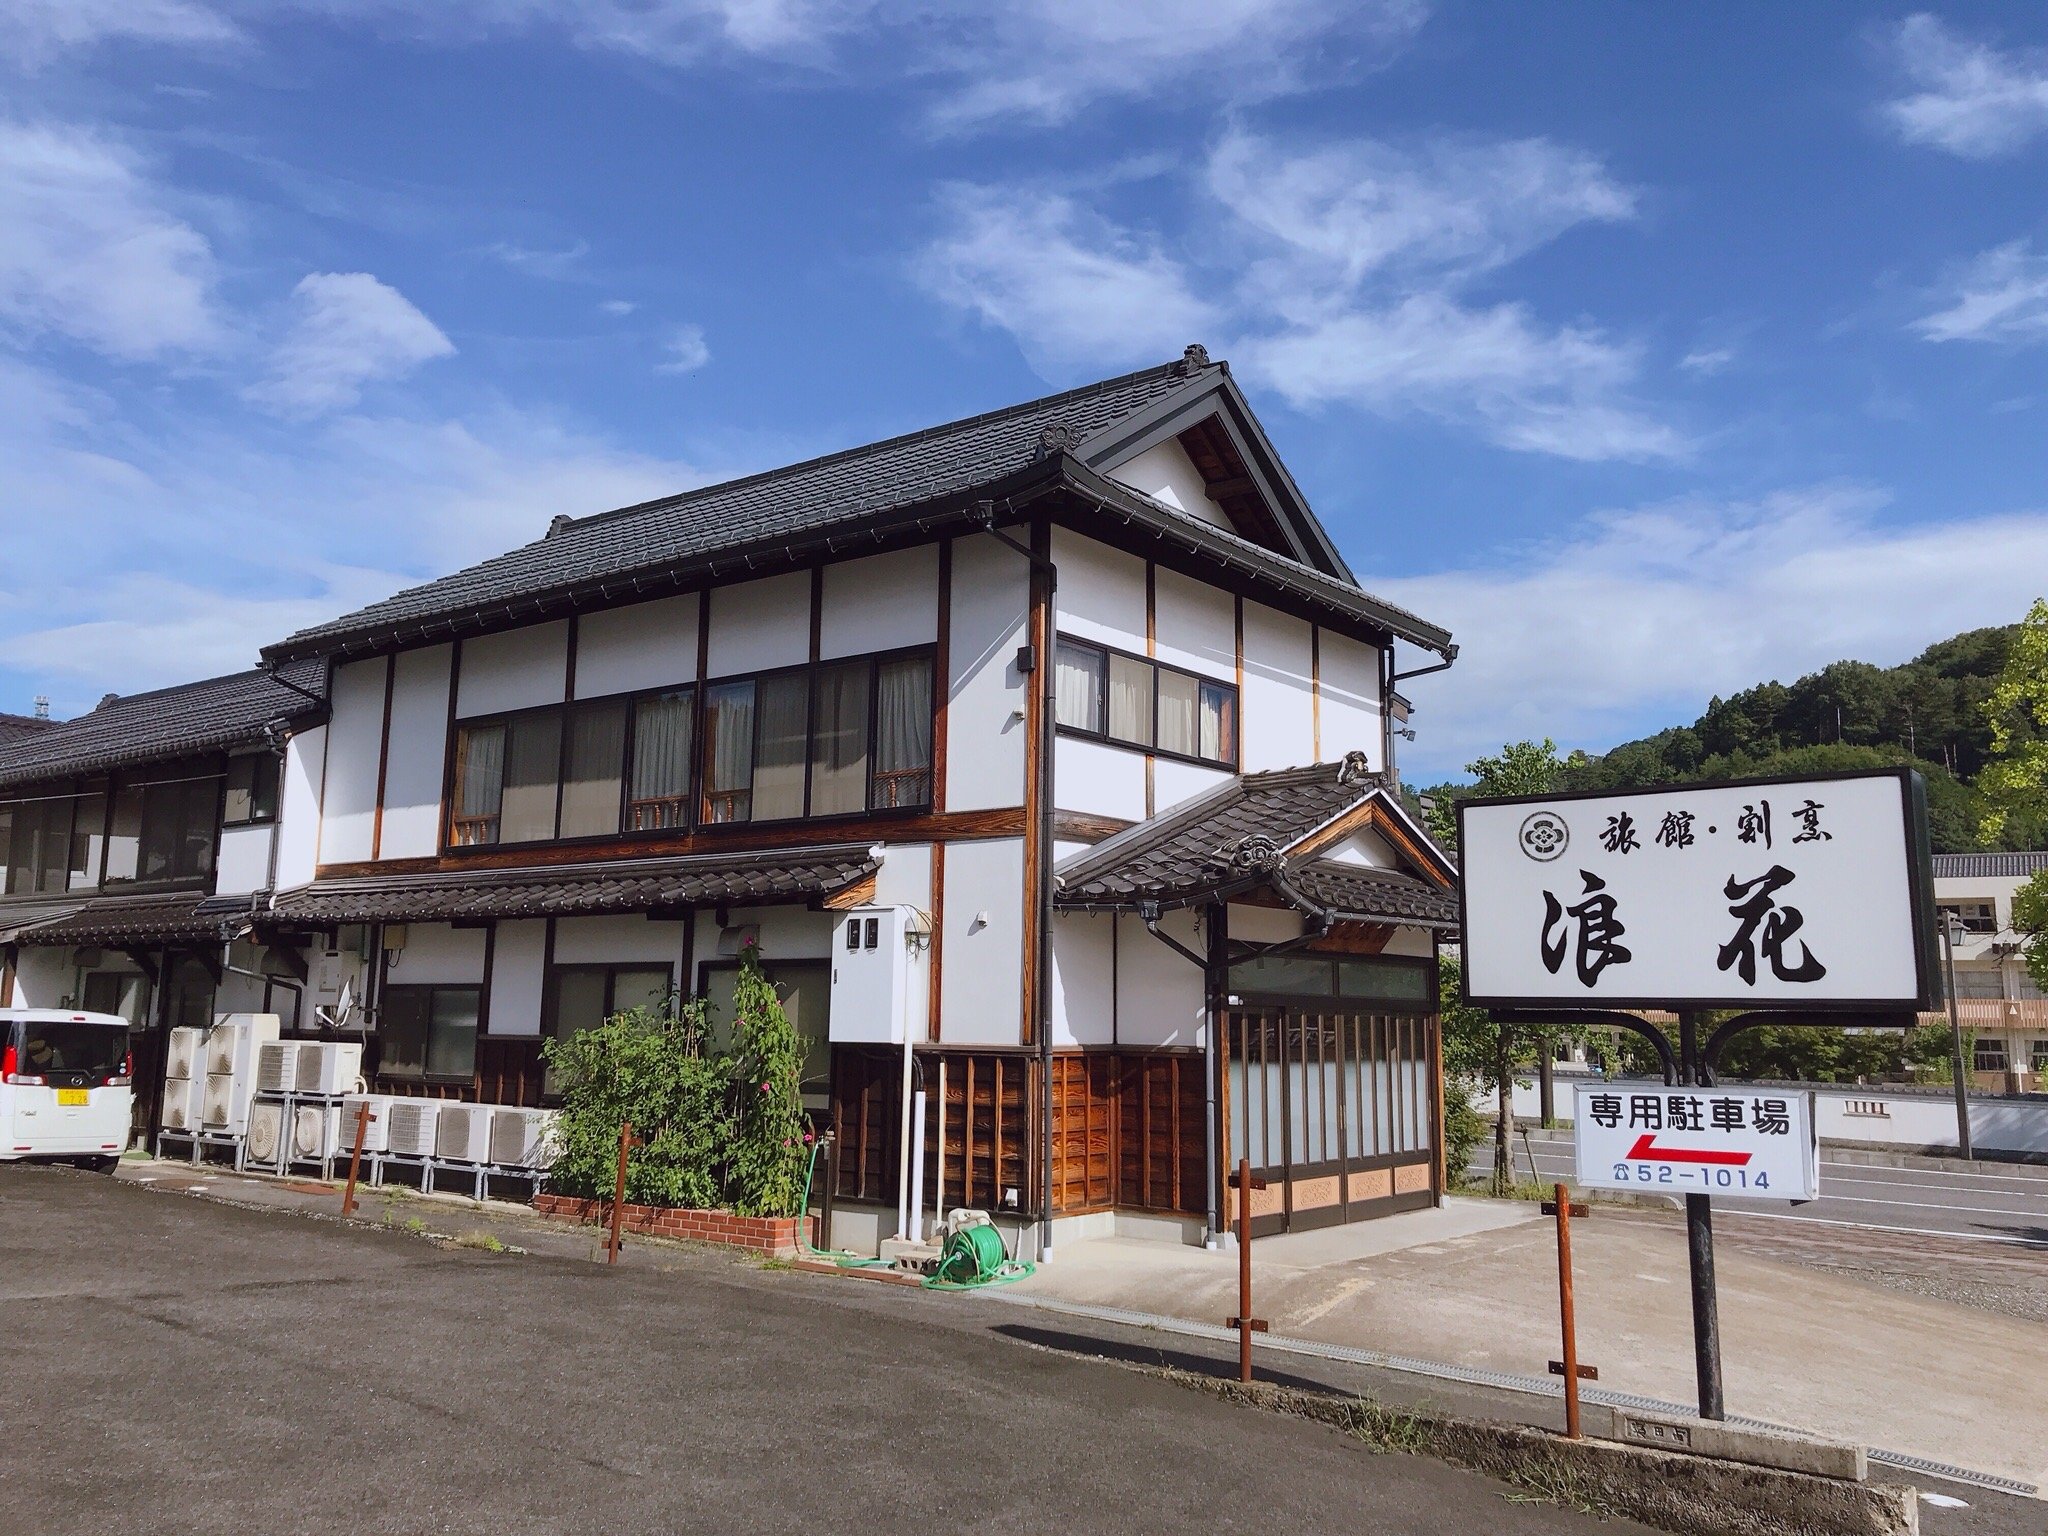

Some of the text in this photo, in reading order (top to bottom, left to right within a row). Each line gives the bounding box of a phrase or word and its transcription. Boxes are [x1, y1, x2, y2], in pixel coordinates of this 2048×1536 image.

[1597, 798, 1833, 855] 旅館・割烹
[1540, 864, 1827, 988] 浪花
[1589, 1092, 1790, 1136] 専用駐車場
[1638, 1164, 1770, 1190] 52-1014
